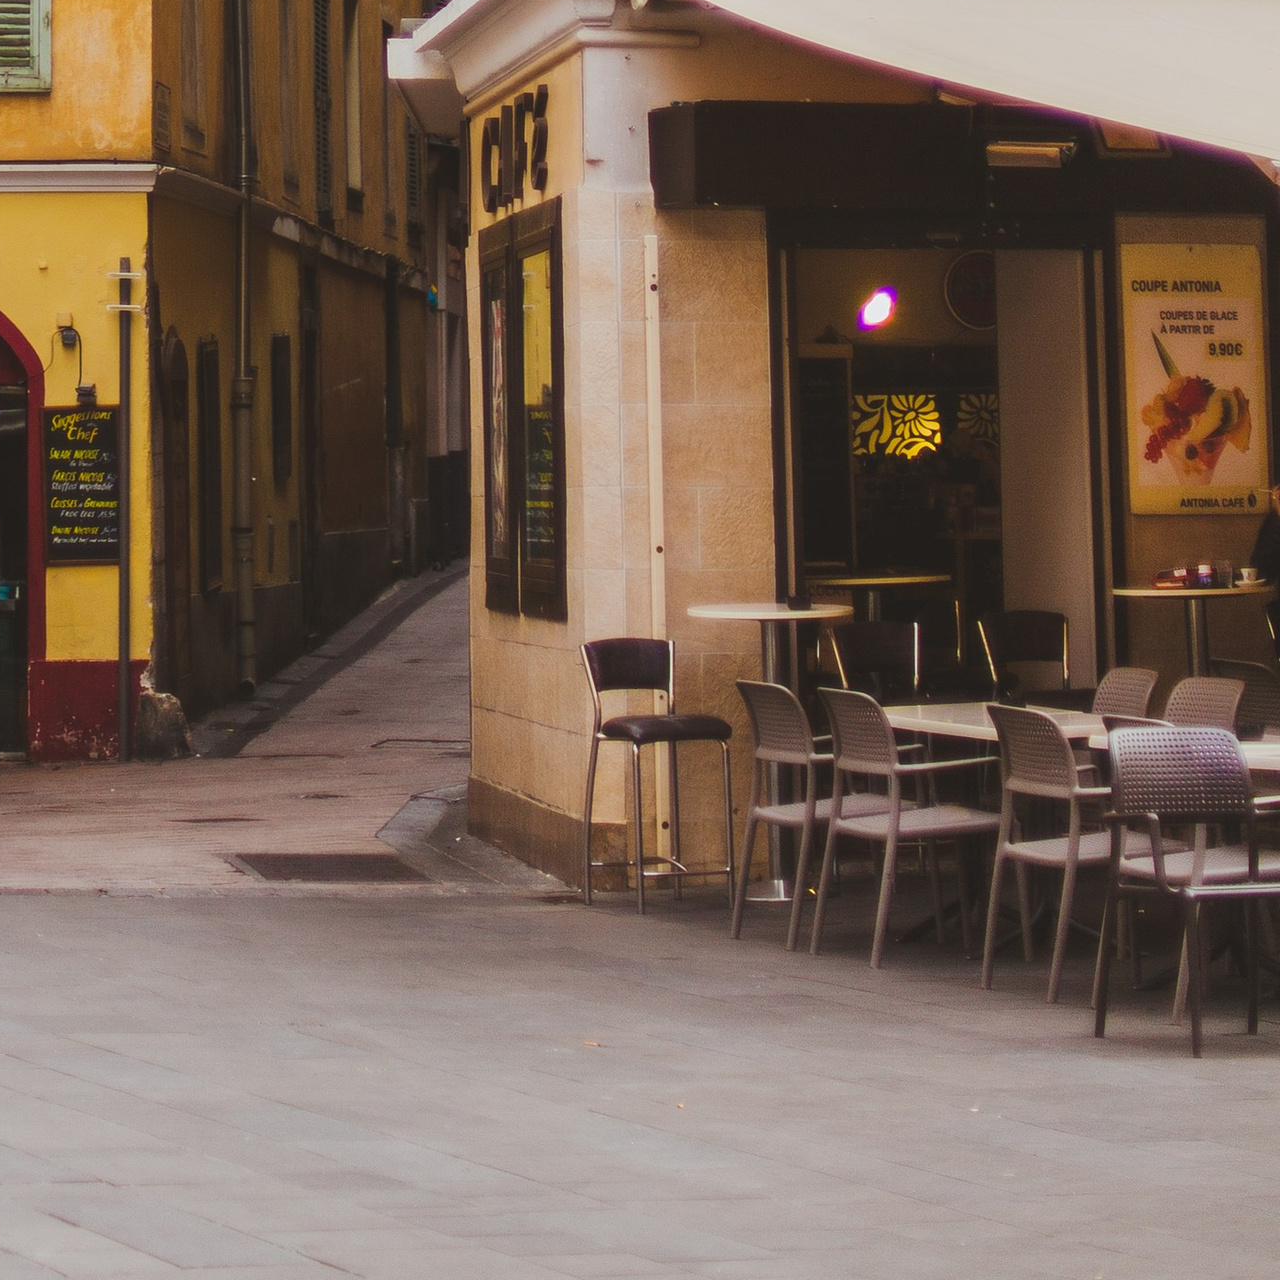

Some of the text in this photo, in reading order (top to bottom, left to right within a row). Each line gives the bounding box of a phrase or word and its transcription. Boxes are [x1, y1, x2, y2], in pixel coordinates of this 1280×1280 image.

[1131, 280, 1223, 293] COUPE ANTONIA
[1160, 310, 1239, 321] COUPES DE GLACE
[1169, 324, 1201, 335] PARTIR
[1203, 325, 1215, 335] DE
[1208, 342, 1243, 357] 9,90€
[51, 411, 112, 431] Suggestions
[67, 427, 99, 444] Chef
[1180, 497, 1220, 508] ANTONIA
